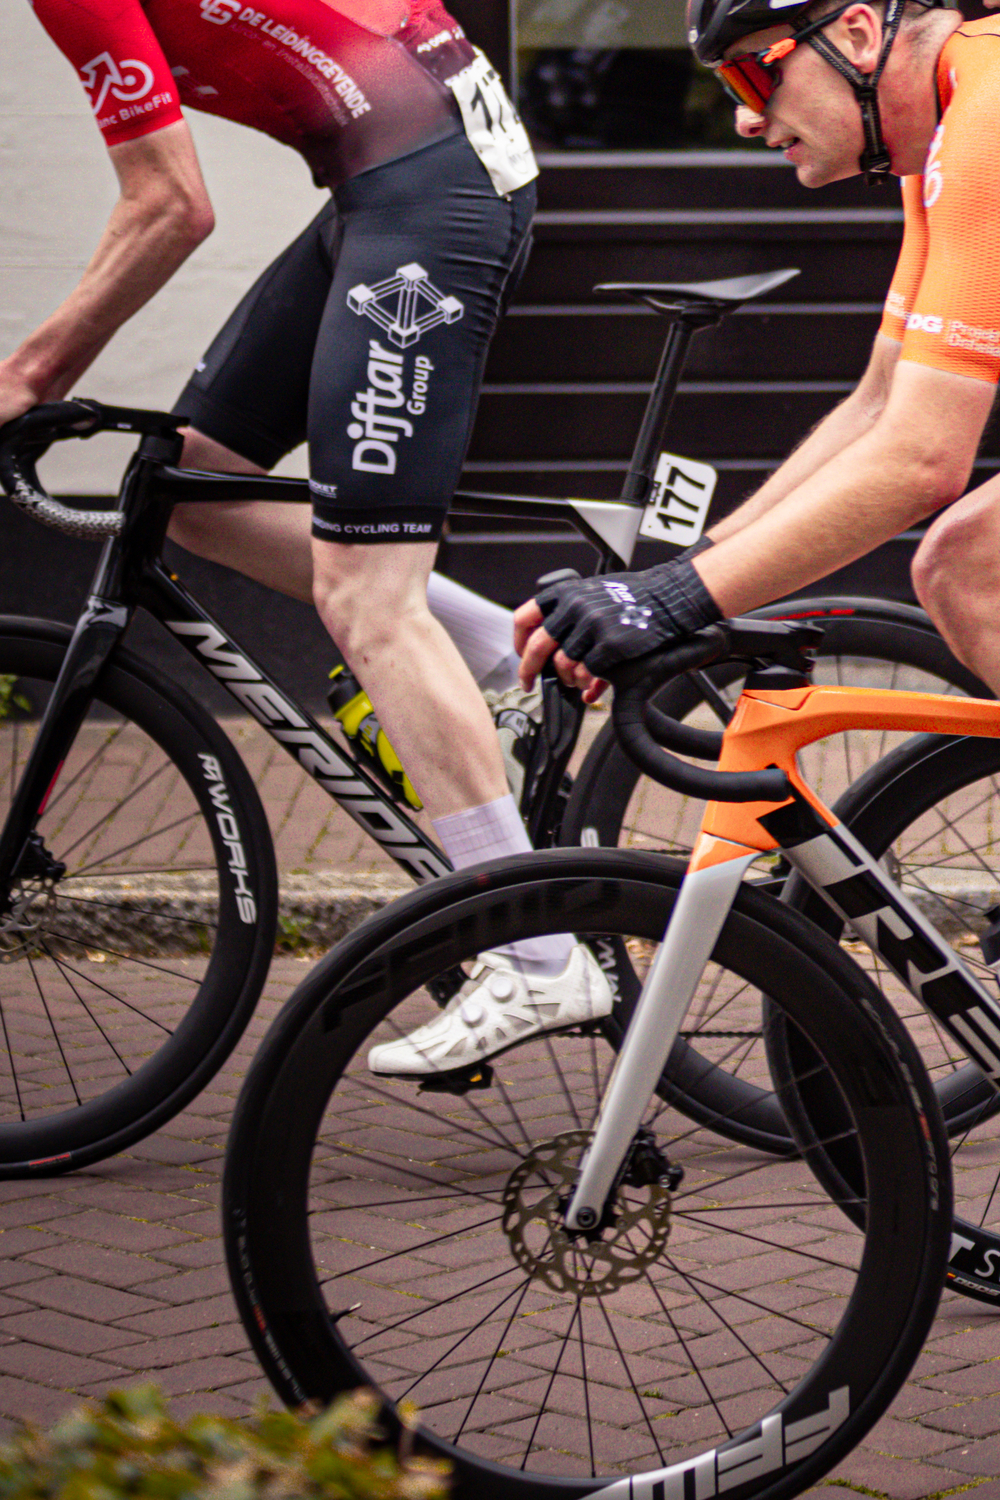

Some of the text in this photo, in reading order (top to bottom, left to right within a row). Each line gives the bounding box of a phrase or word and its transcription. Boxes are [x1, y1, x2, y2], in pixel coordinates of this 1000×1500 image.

[238, 7, 266, 27] DE
[118, 91, 173, 121] BikeFit
[347, 339, 414, 475] Diftar
[406, 355, 435, 415] Group
[656, 466, 706, 531] 177
[343, 523, 400, 534] CYCLING
